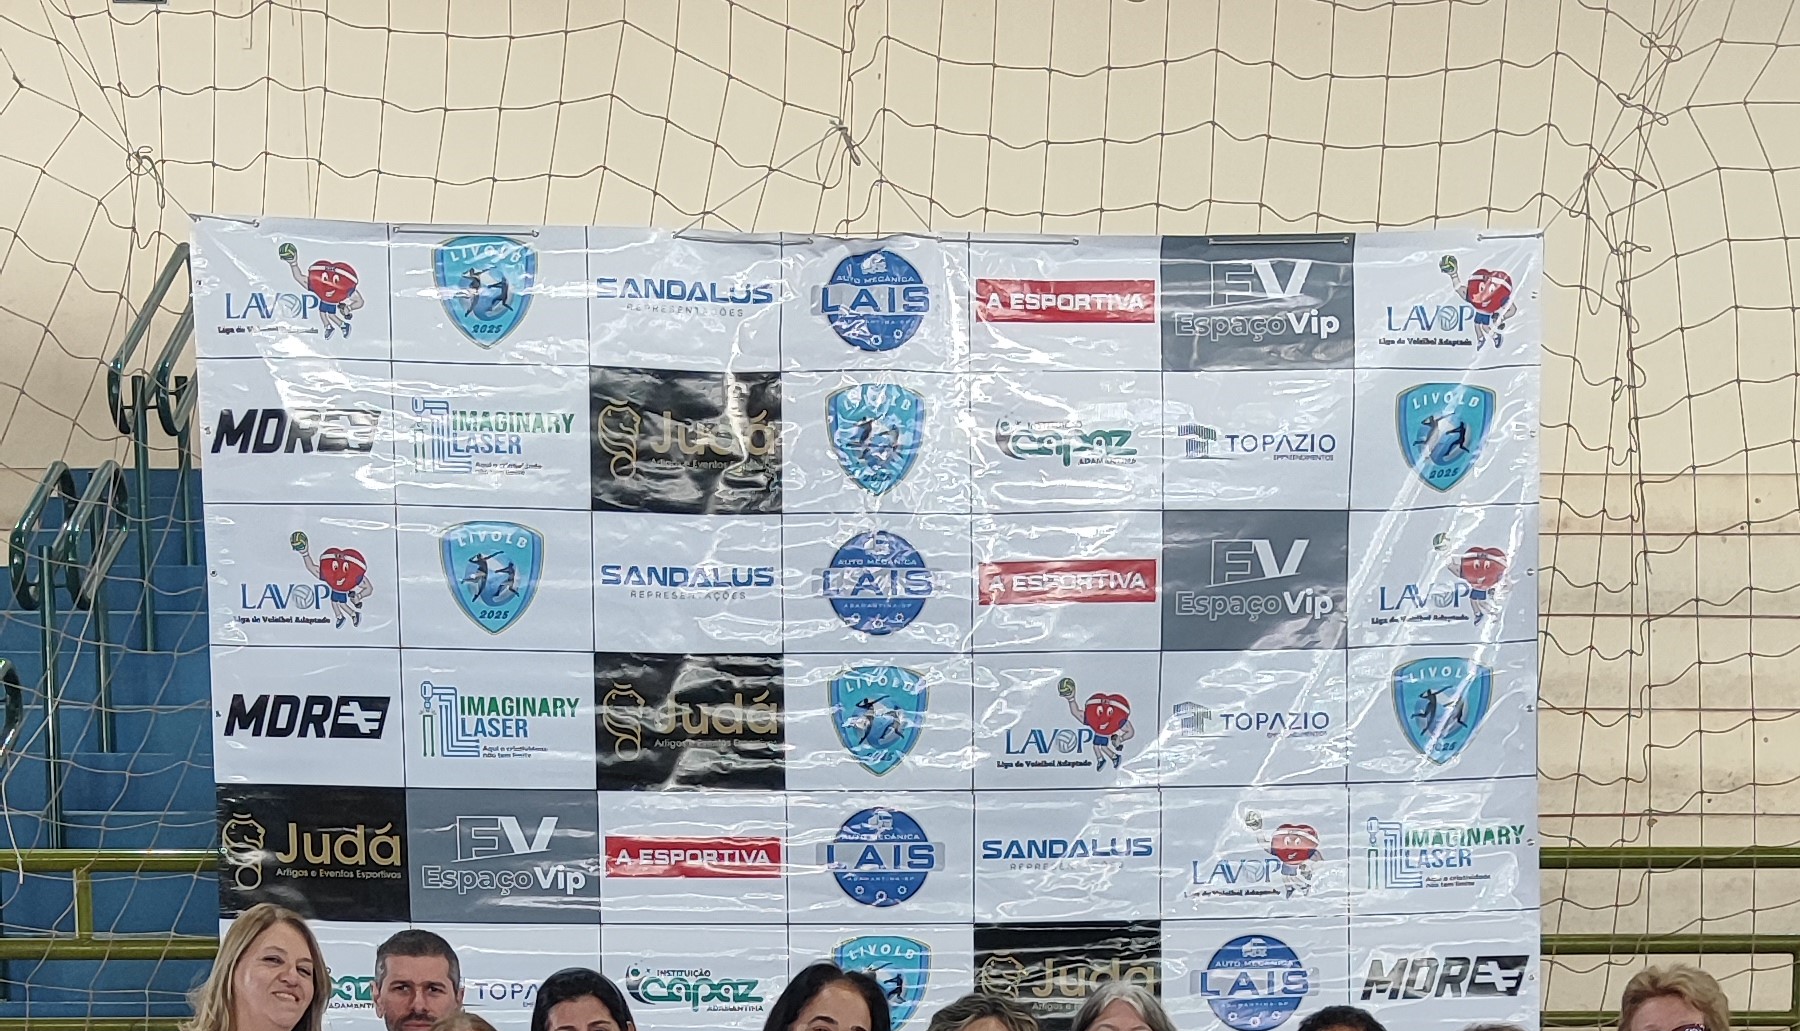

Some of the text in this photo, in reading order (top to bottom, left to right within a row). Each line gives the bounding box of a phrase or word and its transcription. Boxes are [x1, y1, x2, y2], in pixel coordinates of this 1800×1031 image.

[596, 277, 773, 304] SANDALUS
[821, 286, 930, 313] LAIS
[986, 292, 1145, 311] A ESPORTIVA
[472, 325, 503, 333] 2025
[452, 410, 575, 434] IMAGINARY
[452, 432, 522, 455] LASER
[1225, 434, 1336, 453] TOPAZIO
[1429, 468, 1459, 479] 2025
[1211, 539, 1310, 586] EV
[600, 565, 775, 587] SANDALUS
[822, 570, 933, 596] LAIS
[988, 572, 1147, 592] A ESPORTIVA
[479, 610, 509, 619] 2025
[1409, 667, 1472, 682] LIVOL
[460, 695, 580, 718] IMAGINARY
[654, 690, 778, 735] Judá
[461, 717, 529, 738] LASER
[1220, 712, 1330, 730] TOPAZIO
[275, 822, 401, 866] Judá
[456, 816, 559, 861] EV
[1404, 825, 1525, 848] IMAGINARY
[615, 849, 772, 866] A ESPORTIVA
[827, 845, 935, 870] LAIS
[982, 838, 1153, 859] SANDALUS
[1405, 848, 1472, 869] LASER
[276, 868, 308, 877] Artigos
[319, 869, 354, 878] Eventos
[356, 870, 402, 880] Esportivos
[656, 968, 711, 977] INSTITUIÇÃO
[475, 983, 538, 1000] TOPA
[1200, 971, 1309, 997] LAIS
